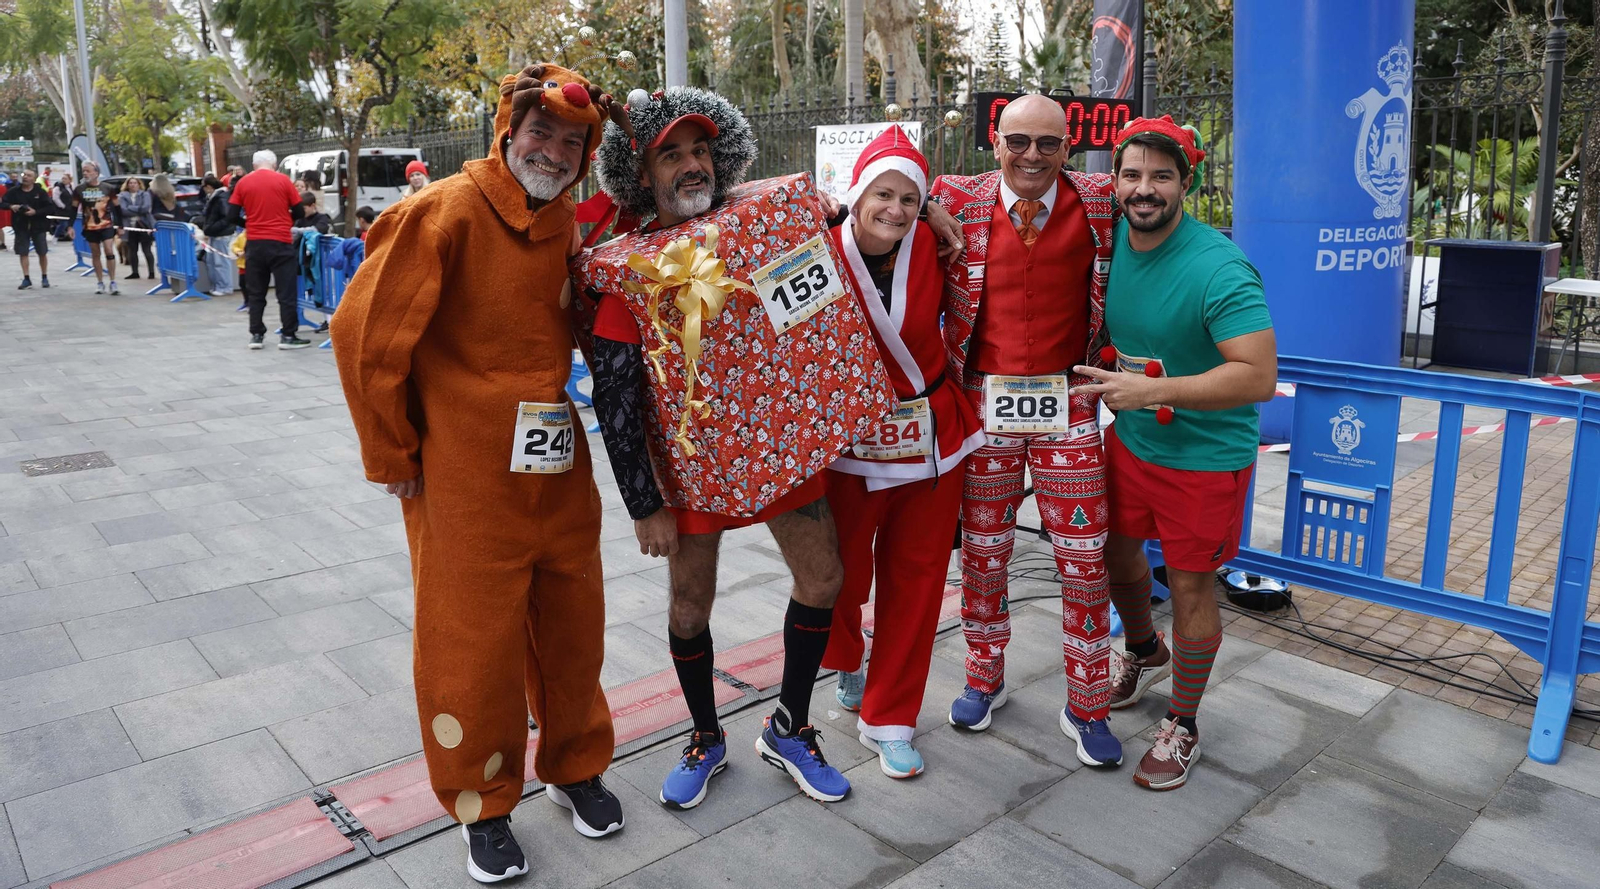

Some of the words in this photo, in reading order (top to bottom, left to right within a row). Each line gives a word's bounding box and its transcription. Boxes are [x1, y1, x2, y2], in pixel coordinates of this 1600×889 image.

[820, 124, 918, 145] ASOCIAN
[771, 264, 829, 311] 153
[995, 396, 1058, 418] 208
[524, 428, 572, 455] 242
[859, 421, 921, 446] 284
[1351, 456, 1376, 466] Algeciras
